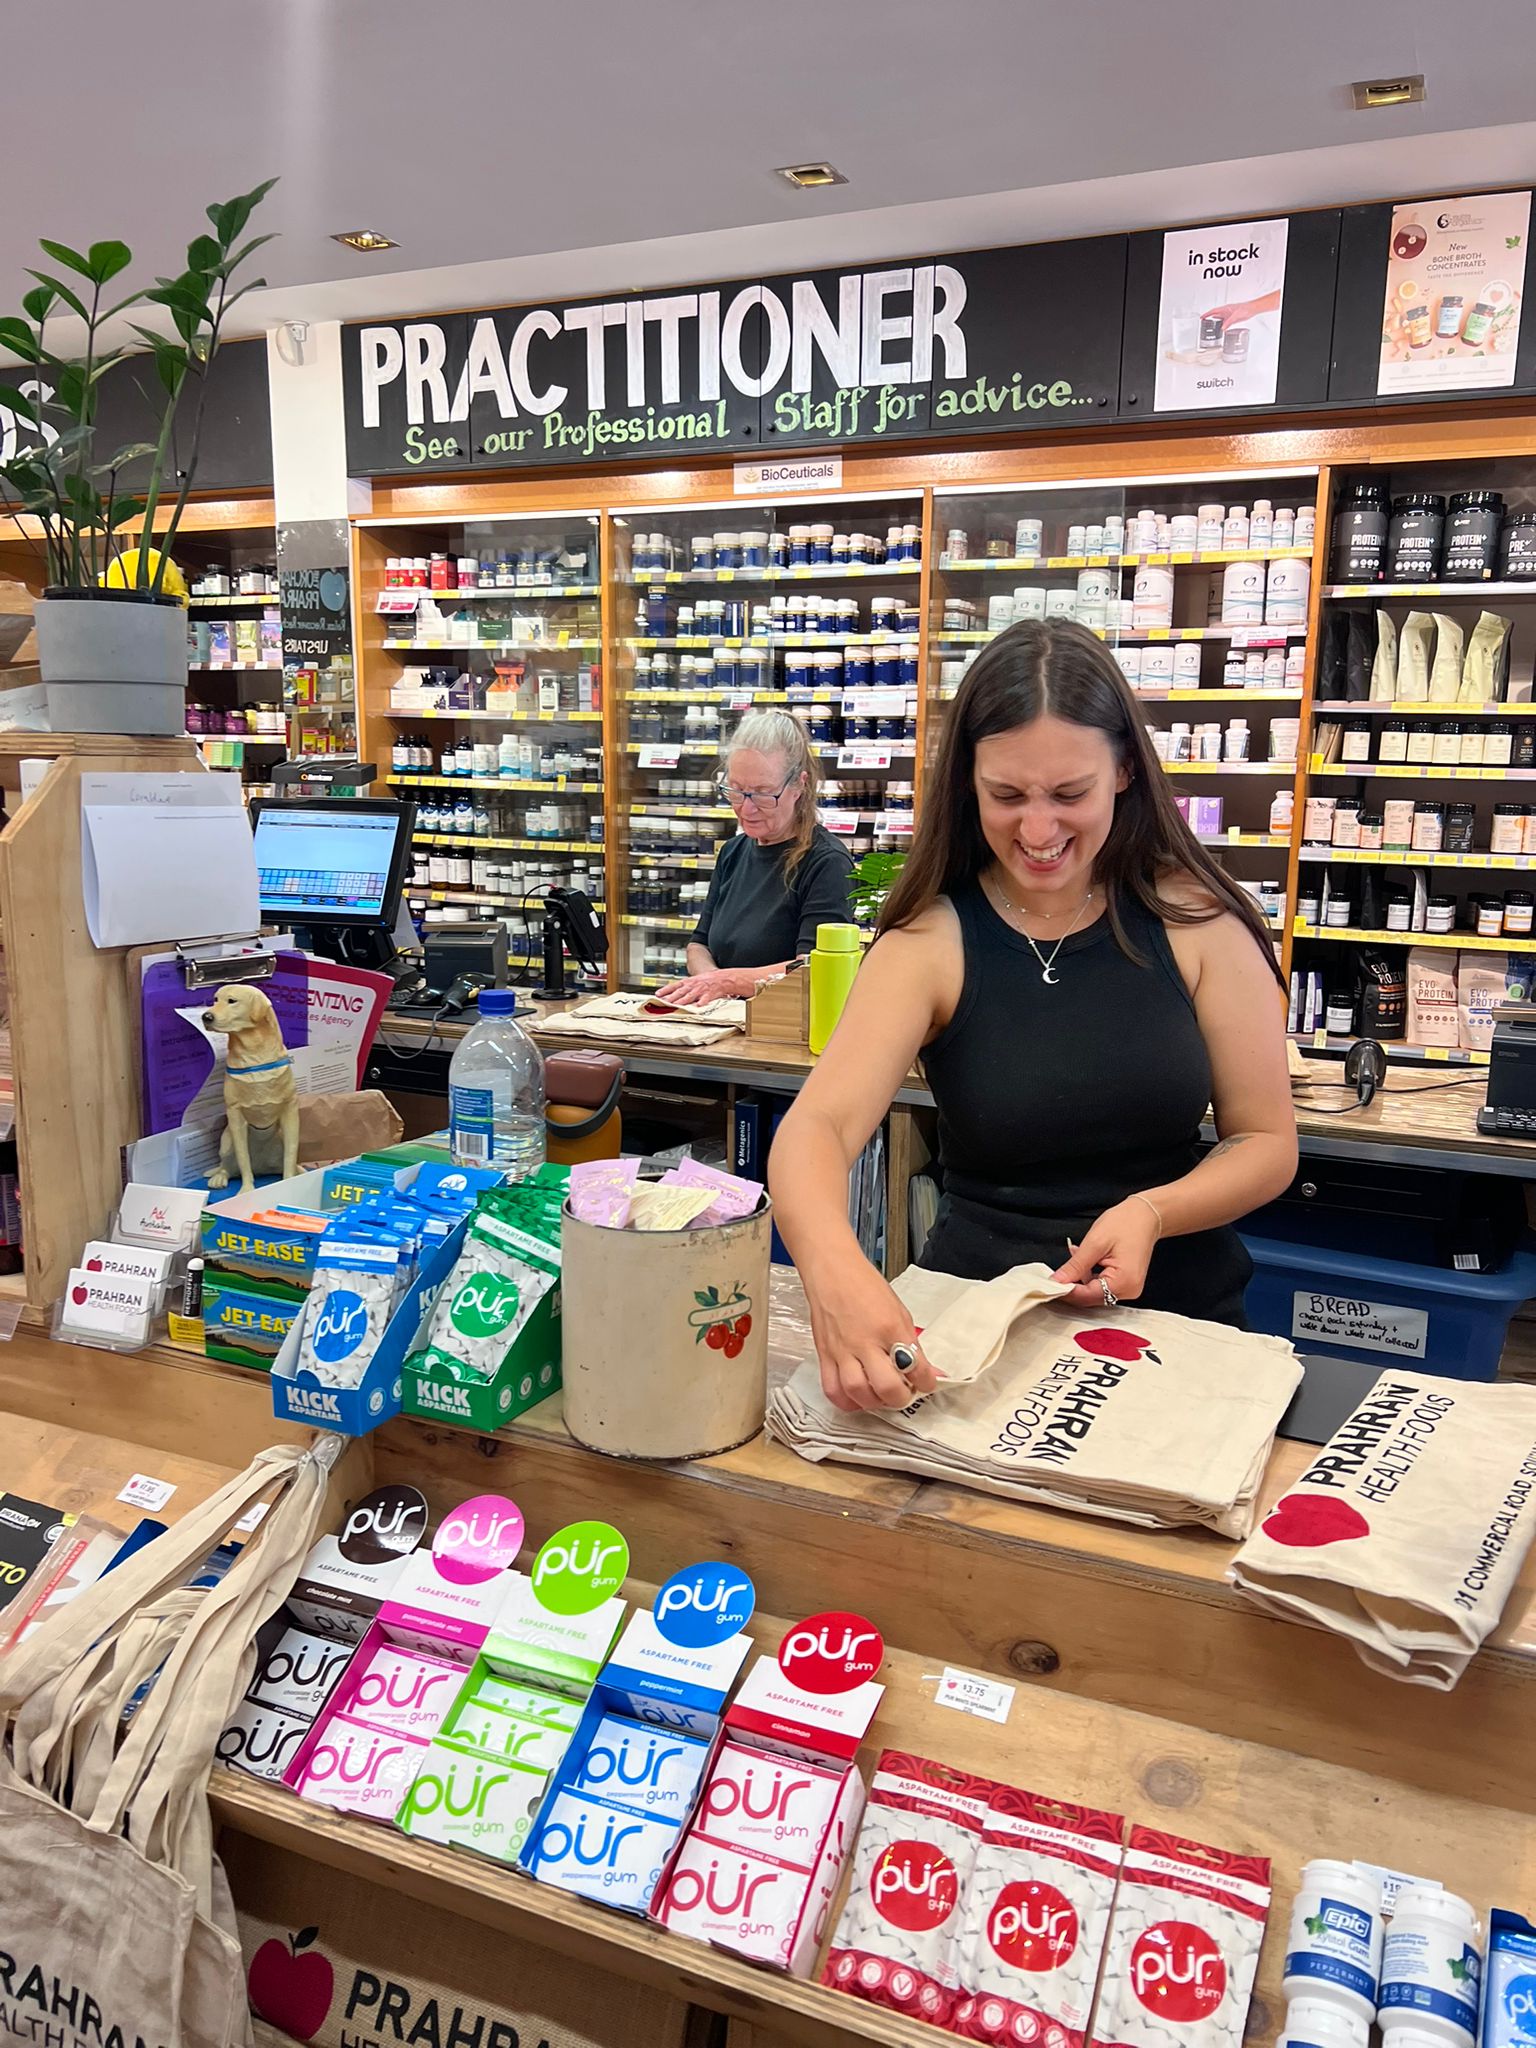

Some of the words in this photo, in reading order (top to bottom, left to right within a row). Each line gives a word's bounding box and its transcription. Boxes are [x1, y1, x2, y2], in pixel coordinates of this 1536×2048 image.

[1188, 250, 1204, 266] in
[1208, 243, 1260, 264] stock
[1432, 253, 1454, 263] BONE
[1456, 252, 1482, 262] BROTH
[1448, 243, 1467, 252] New
[1203, 264, 1242, 280] now
[1426, 259, 1487, 272] CONCENTRATES
[360, 264, 968, 428] PRACTITIONER
[1196, 376, 1235, 389] switch
[402, 426, 459, 465] See
[484, 427, 534, 456] our
[542, 399, 731, 456] Professional
[773, 386, 870, 438] Staff
[873, 383, 926, 434] for
[760, 464, 834, 481] BioCeuticals
[1418, 989, 1454, 1000] PROTEIN
[1419, 979, 1436, 989] EVO
[1470, 988, 1488, 998] EVO
[321, 1014, 353, 1027] Agency
[330, 1184, 365, 1203] JET
[217, 1231, 250, 1253] JET
[254, 1239, 306, 1263] EASE
[104, 1260, 157, 1279] PRAHRAN
[87, 1300, 115, 1312] HEALTH
[88, 1288, 143, 1307] PRAHRAN
[221, 1305, 256, 1327] JET
[488, 1315, 509, 1327] gum
[343, 1331, 364, 1343] gum
[1028, 1353, 1083, 1401] HEALTH
[285, 1384, 341, 1414] KICK
[416, 1378, 470, 1408] KICK
[287, 1404, 343, 1423] ASPARTAME
[416, 1397, 473, 1418] ASPARTAME
[1023, 1357, 1129, 1466] PRAHRAN
[989, 1396, 1049, 1458] FOODS
[1300, 1382, 1420, 1488] PRAHRAN
[1355, 1438, 1423, 1503] HEALTH
[1398, 1393, 1456, 1444] FOODS
[340, 1499, 425, 1544] pür
[391, 1535, 415, 1546] gum
[434, 1511, 522, 1559] pür
[1463, 1509, 1519, 1592] COMMERCIAL
[318, 1562, 360, 1580] ASPARTAME
[361, 1573, 379, 1584] FREE
[535, 1539, 623, 1587] pür
[591, 1577, 618, 1589] gum
[305, 1586, 338, 1600] chocolate
[338, 1595, 353, 1604] mint
[415, 1585, 460, 1602] ASPARTAME
[462, 1597, 481, 1608] FREE
[657, 1578, 749, 1621] pür
[518, 1616, 566, 1635] ASPARTAME
[566, 1628, 588, 1641] FREE
[716, 1613, 744, 1625] gum
[782, 1626, 878, 1667] pür
[252, 1644, 351, 1697] pür
[639, 1648, 689, 1666] ASPARTAME
[690, 1659, 713, 1672] FREE
[844, 1662, 874, 1673] gum
[344, 1665, 451, 1714] pür
[639, 1679, 684, 1696] peppermint
[963, 1683, 985, 1697] $3.75
[765, 1692, 819, 1712] ASPARTAME
[820, 1705, 845, 1718] FREE
[408, 1710, 440, 1725] gum
[771, 1722, 811, 1738] cinnamon
[300, 1736, 405, 1796] pür
[578, 1737, 685, 1789] pür
[763, 1753, 798, 1768] ASPARTAME
[797, 1762, 813, 1773] FREE
[361, 1786, 393, 1802] gum
[404, 1763, 511, 1833] pür
[646, 1789, 680, 1804] gum
[698, 1768, 812, 1832] pür
[898, 1780, 955, 1804] ASPARTAME
[955, 1797, 980, 1813] FREE
[598, 1799, 630, 1814] ASPARTAME
[629, 1808, 646, 1818] FREE
[471, 1822, 504, 1838] gum
[738, 1825, 773, 1834] cinnamon
[774, 1822, 810, 1840] gum
[1010, 1822, 1070, 1842] ASPARTAME
[1071, 1835, 1097, 1851] FREE
[530, 1813, 644, 1874] pür
[730, 1843, 764, 1861] ASPARTAME
[763, 1854, 780, 1866] FREE
[602, 1870, 638, 1887] gum
[875, 1859, 958, 1905] pür
[1151, 1858, 1215, 1882] ASPARTAME
[1216, 1876, 1243, 1890] FREE
[662, 1859, 779, 1925] pür
[739, 1921, 775, 1938] gum
[993, 1901, 1072, 1946] pür
[1348, 1940, 1370, 1960] Gum
[1137, 1945, 1224, 1996] pür
[1310, 1961, 1369, 1990] PEPPERMINT
[1194, 1986, 1222, 2000] gum
[344, 1968, 552, 2048] PRAHR
